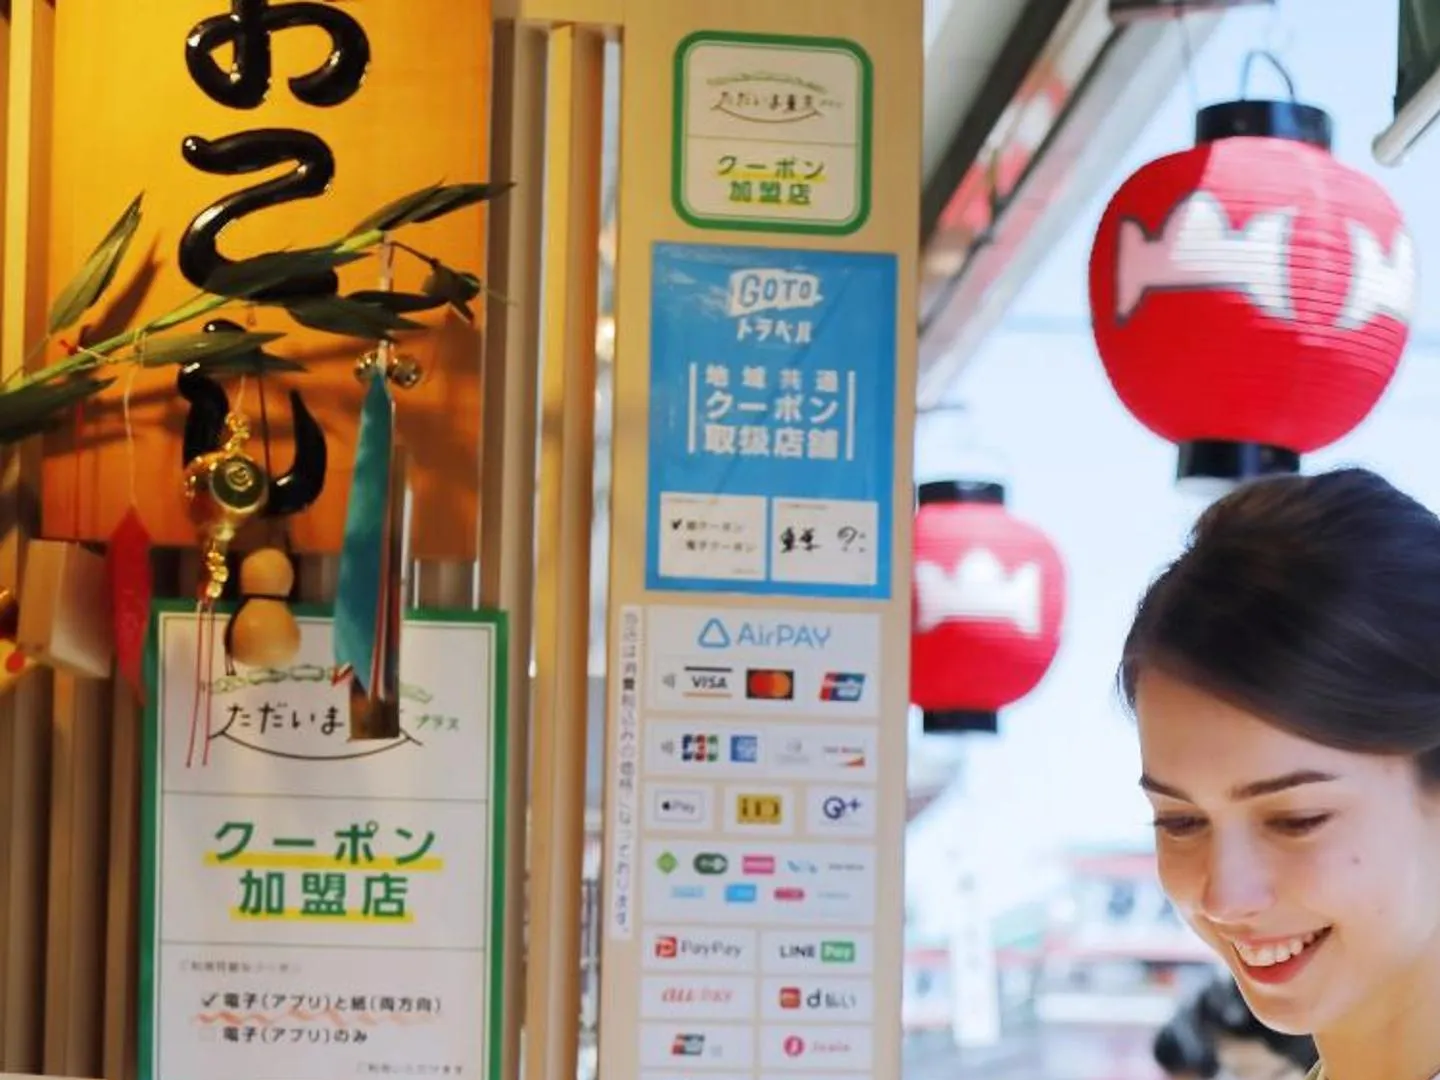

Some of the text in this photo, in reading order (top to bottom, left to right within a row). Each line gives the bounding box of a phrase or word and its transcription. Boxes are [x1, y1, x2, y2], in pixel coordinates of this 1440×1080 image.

[737, 316, 813, 343] トラベル
[706, 390, 839, 424] クーポン
[691, 675, 728, 689] VISA
[215, 820, 435, 865] クーポン
[239, 869, 408, 917] 加盟店
[780, 943, 815, 959] LINE
